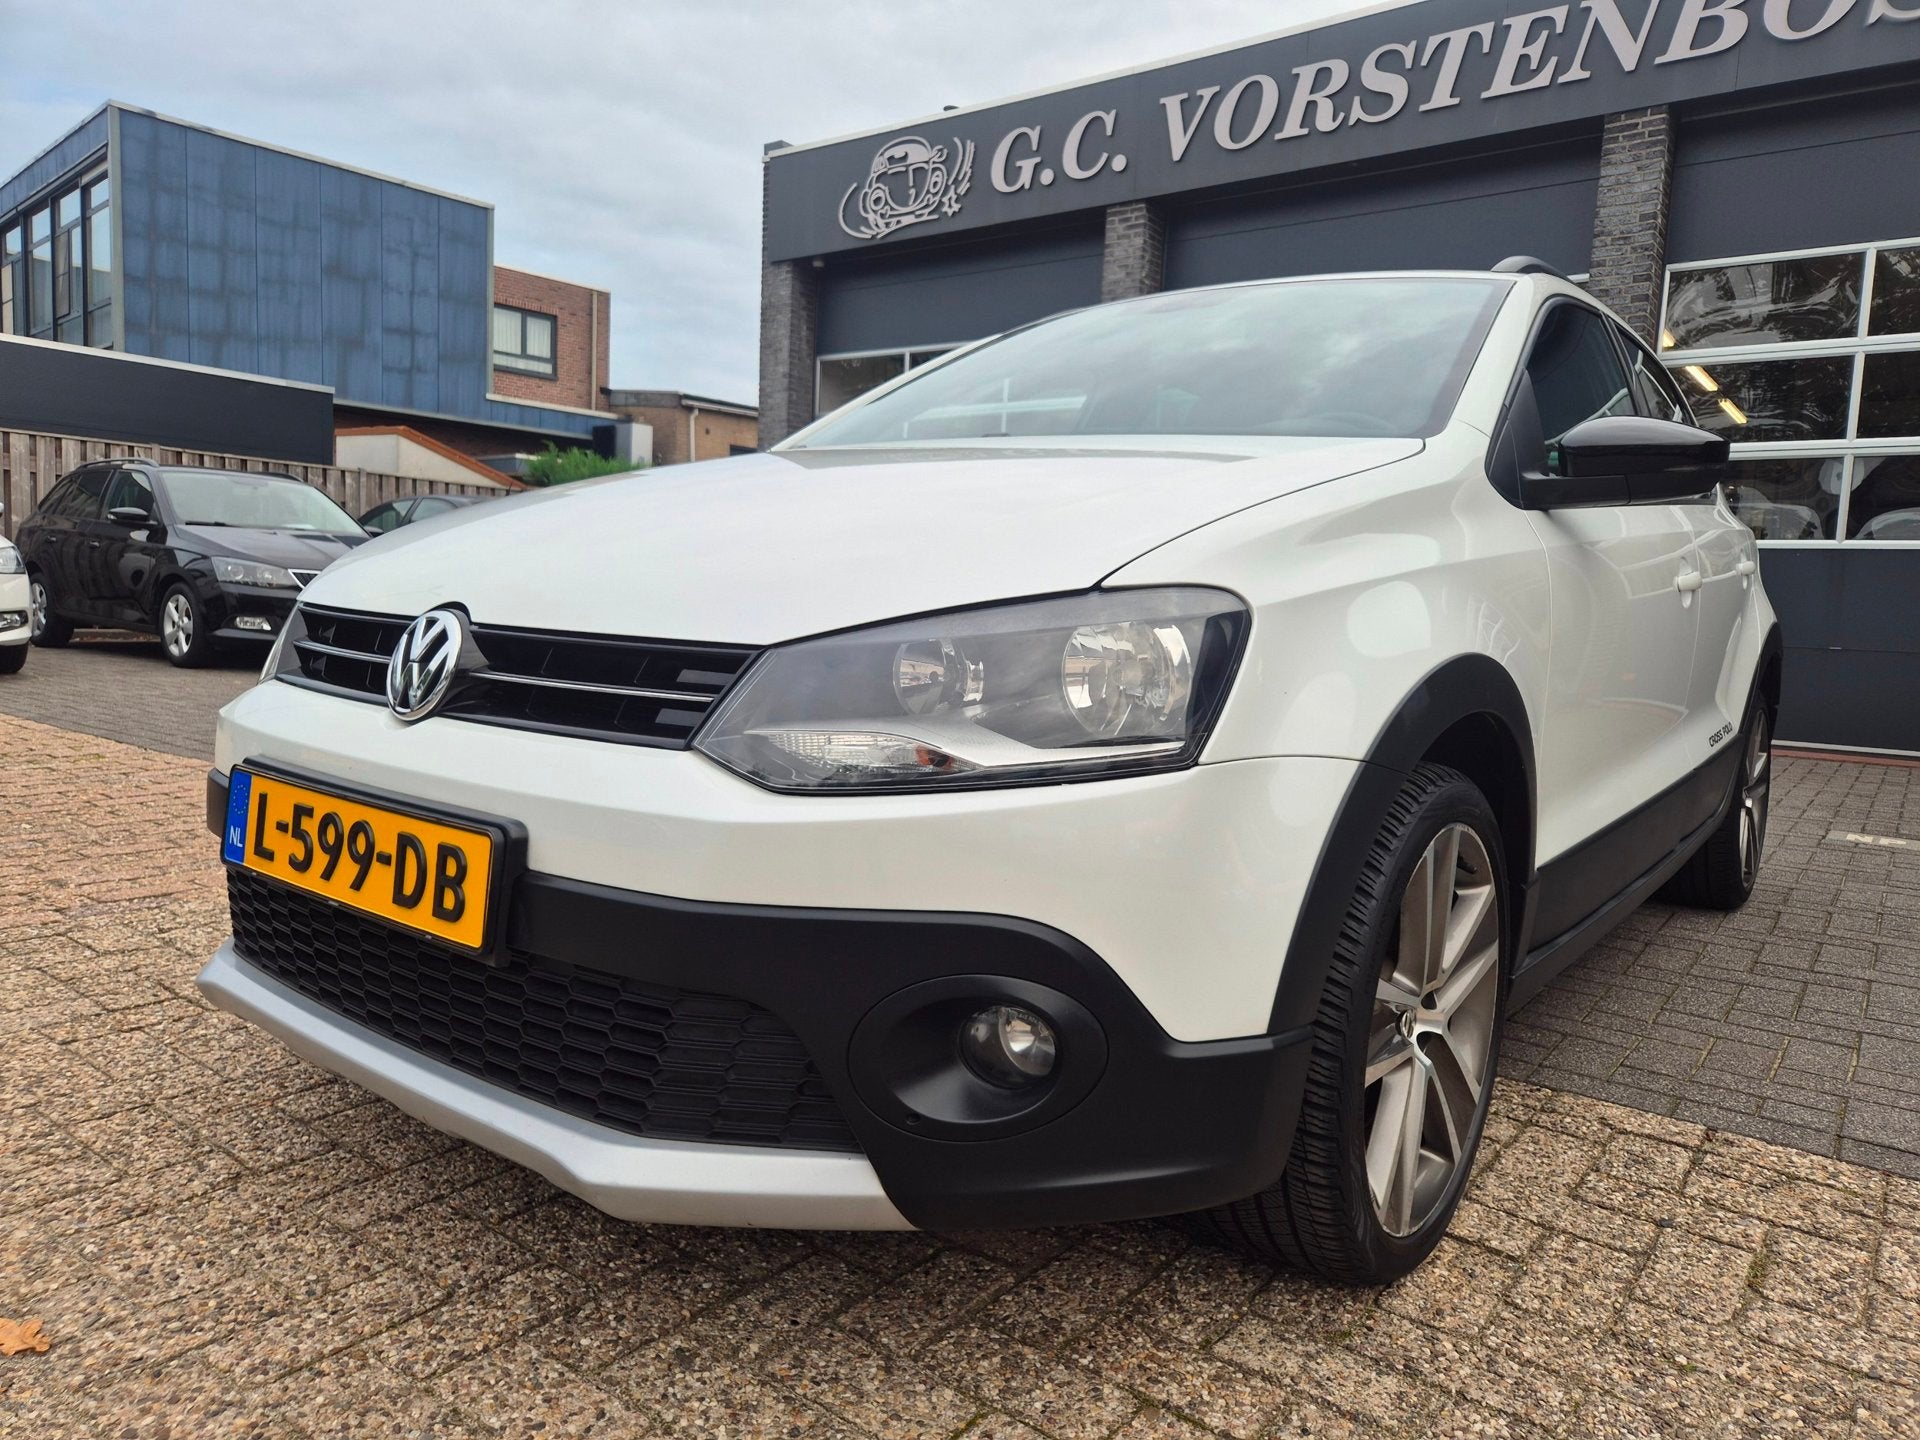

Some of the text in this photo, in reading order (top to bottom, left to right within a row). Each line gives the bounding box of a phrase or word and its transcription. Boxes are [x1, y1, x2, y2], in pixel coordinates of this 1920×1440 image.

[990, 0, 1920, 193] G.C. VORSTENB
[1708, 721, 1733, 748] CROSS POLO
[229, 825, 243, 848] NL
[253, 792, 468, 923] L-599-DB
